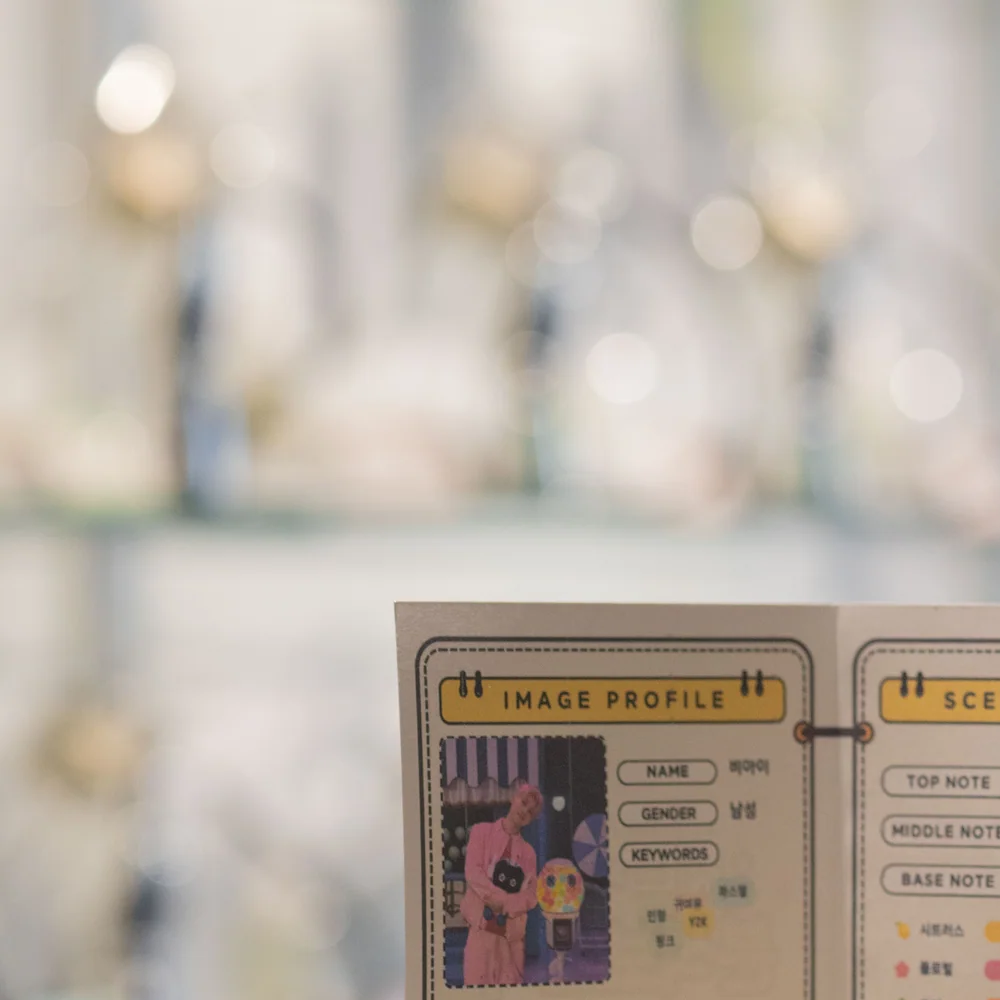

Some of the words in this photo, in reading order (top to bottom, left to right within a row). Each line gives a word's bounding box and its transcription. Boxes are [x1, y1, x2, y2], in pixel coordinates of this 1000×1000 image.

[504, 690, 590, 710] IMAGE
[607, 690, 724, 709] PROFILE
[646, 765, 689, 778] NAME
[907, 774, 940, 789] TOP
[945, 775, 991, 790] NOTE
[641, 807, 697, 820] GENDER
[730, 801, 757, 820] 남성
[892, 823, 953, 839] MIDDLE
[631, 847, 708, 862] KEYWORDS
[901, 872, 943, 887] BASE
[950, 874, 995, 889] NOTE
[920, 923, 965, 937] 시트러스
[920, 961, 953, 976] 플로럴
